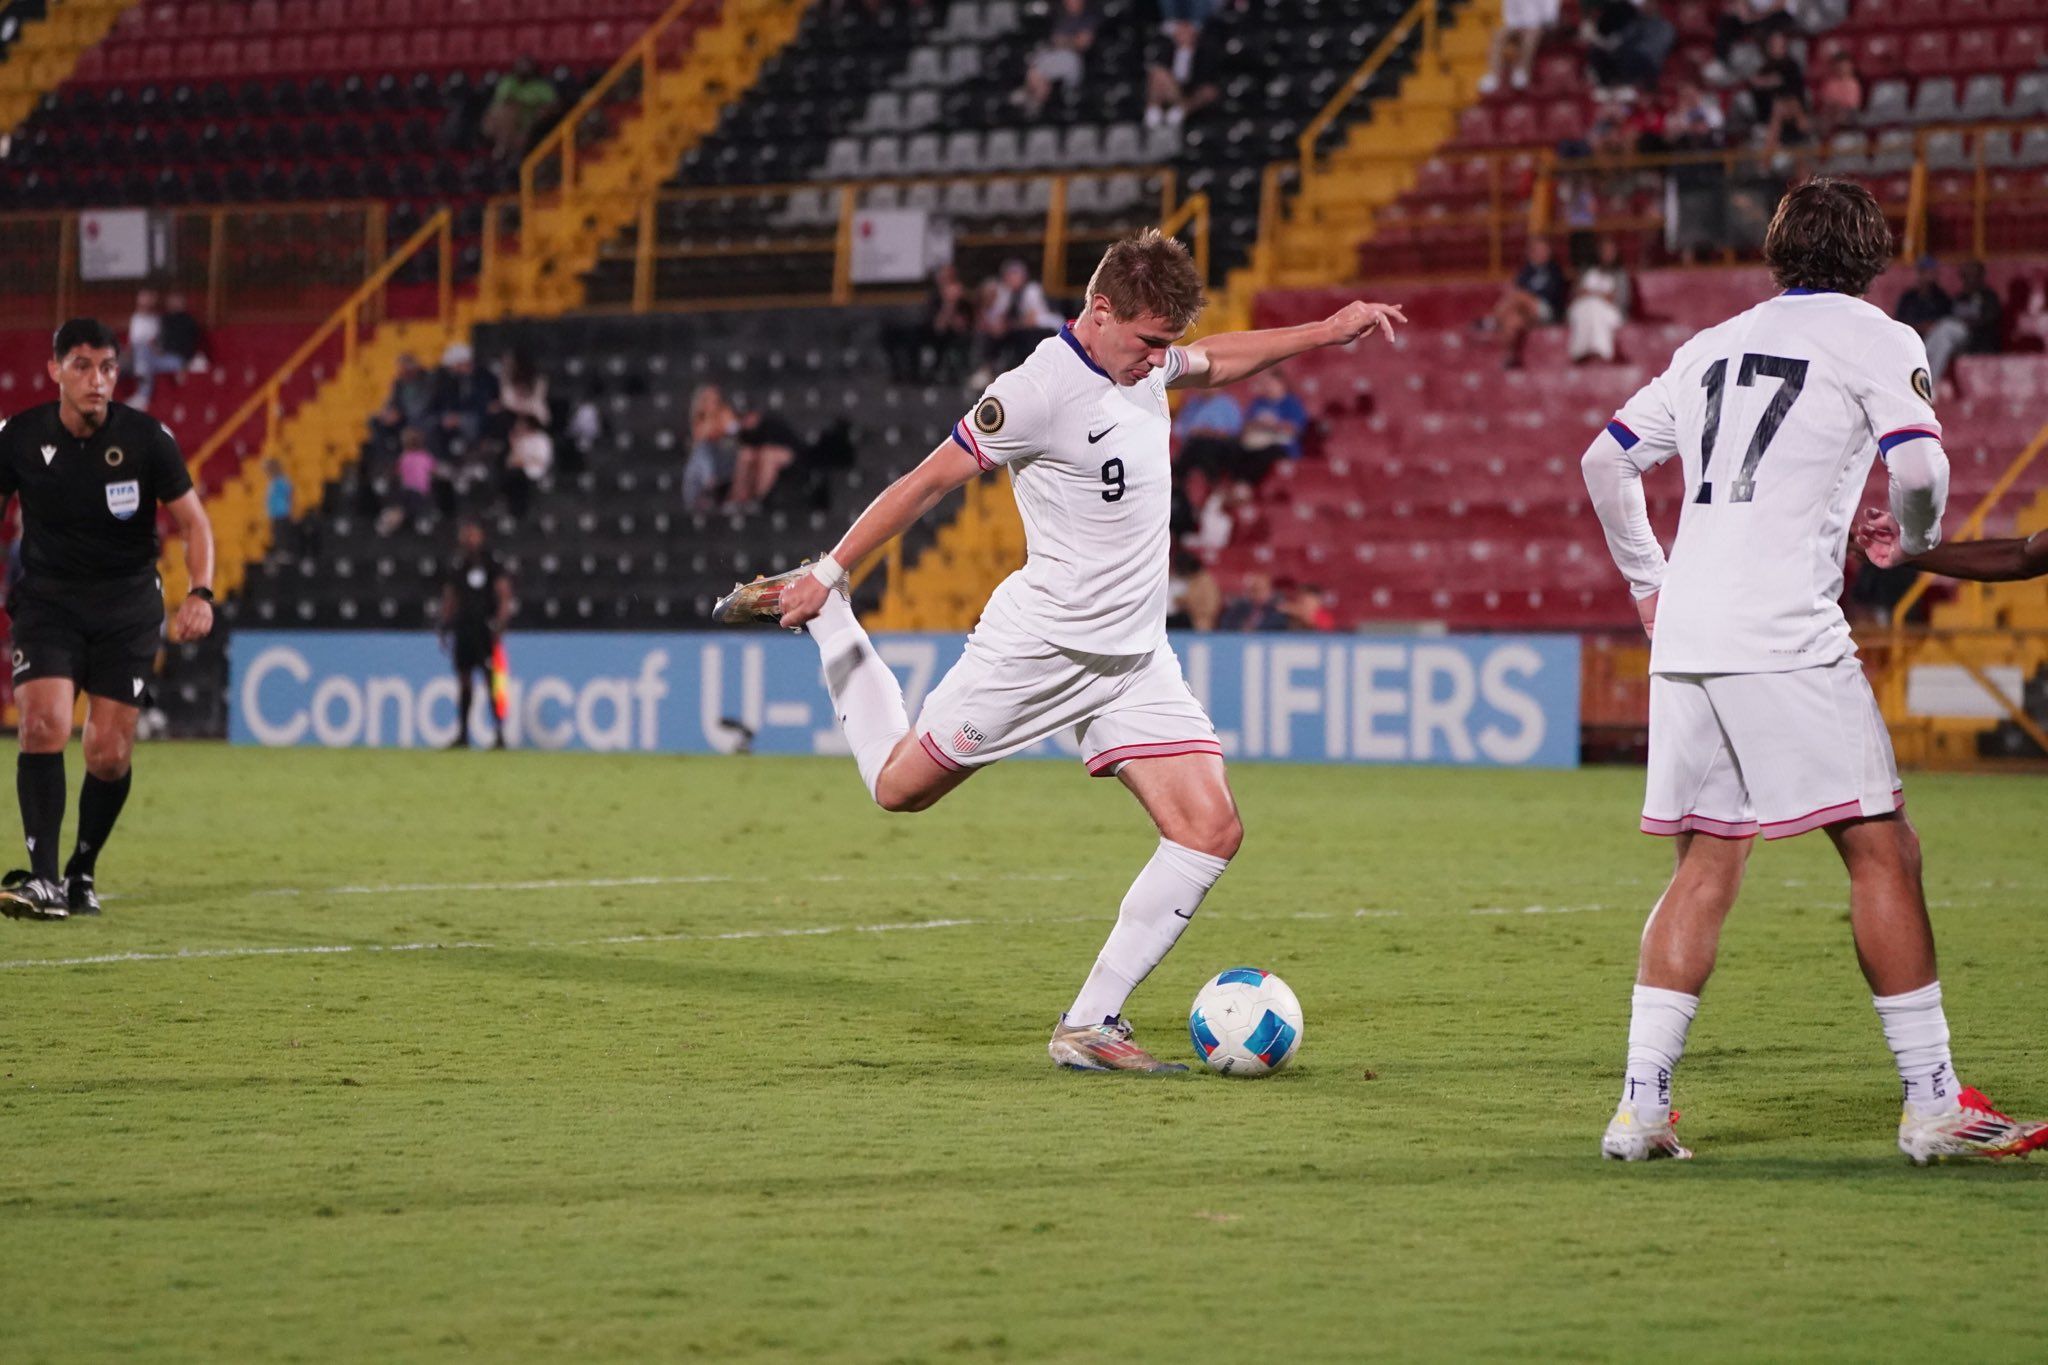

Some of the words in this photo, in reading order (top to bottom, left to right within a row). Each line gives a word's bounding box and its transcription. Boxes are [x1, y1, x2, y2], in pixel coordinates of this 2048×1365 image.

[1692, 352, 1810, 504] 17
[109, 485, 135, 497] FIFA
[1101, 457, 1126, 503] 9
[703, 642, 937, 756] U-7
[962, 723, 984, 742] USA
